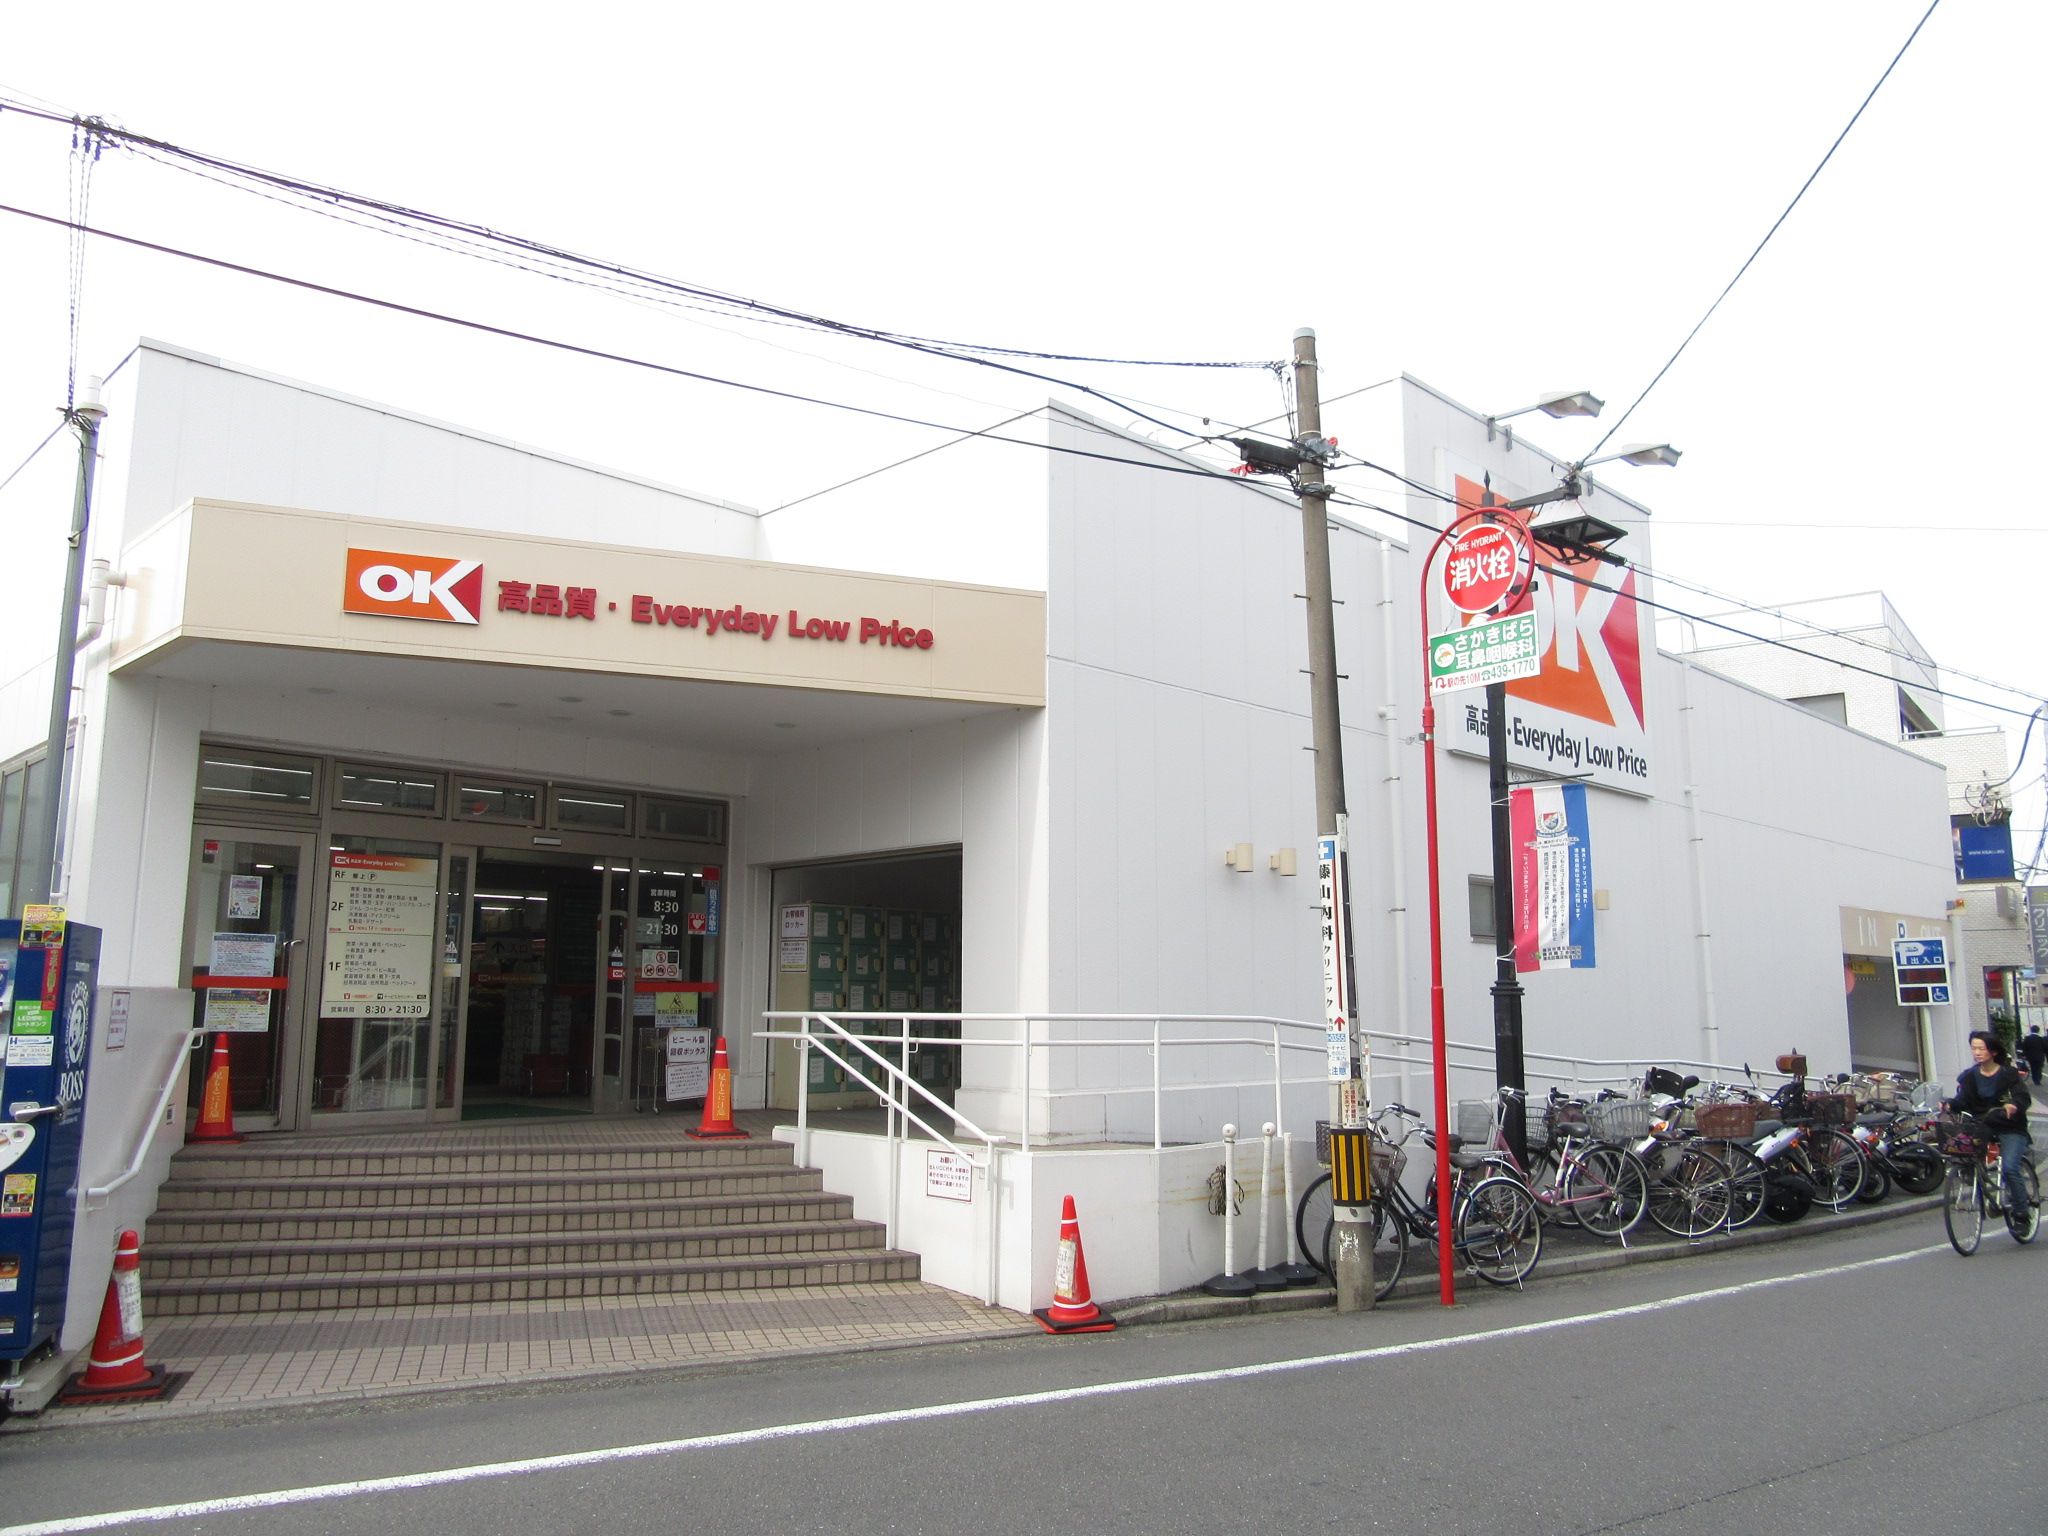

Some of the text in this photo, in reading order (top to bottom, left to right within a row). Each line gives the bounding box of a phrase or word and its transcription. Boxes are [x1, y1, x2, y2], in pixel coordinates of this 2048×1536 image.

[1454, 532, 1503, 554] FIRE HYDRANT
[1449, 545, 1511, 592] 消火栓
[359, 560, 483, 624] OK
[631, 594, 779, 640] Everyday
[788, 610, 850, 641] Low
[860, 617, 934, 649] Price
[1454, 618, 1534, 651] さかきばら
[1455, 636, 1535, 669] 耳鼻咽喉科
[1490, 658, 1535, 679] 439-1770
[1585, 736, 1613, 769] Low
[1617, 745, 1648, 778] Price
[335, 870, 346, 878] RF
[650, 889, 677, 898] 営業時間
[331, 901, 344, 911] 2F
[653, 900, 679, 913] 8:30
[646, 923, 678, 935] 21:30
[1858, 915, 1878, 947] IN
[2033, 908, 2048, 958] クリニック
[329, 961, 341, 971] 1F
[1911, 956, 1942, 965] 出入口
[365, 1005, 422, 1014] 8:30 21:30
[1327, 1034, 1346, 1042] -0355
[60, 1070, 84, 1101] BOSS
